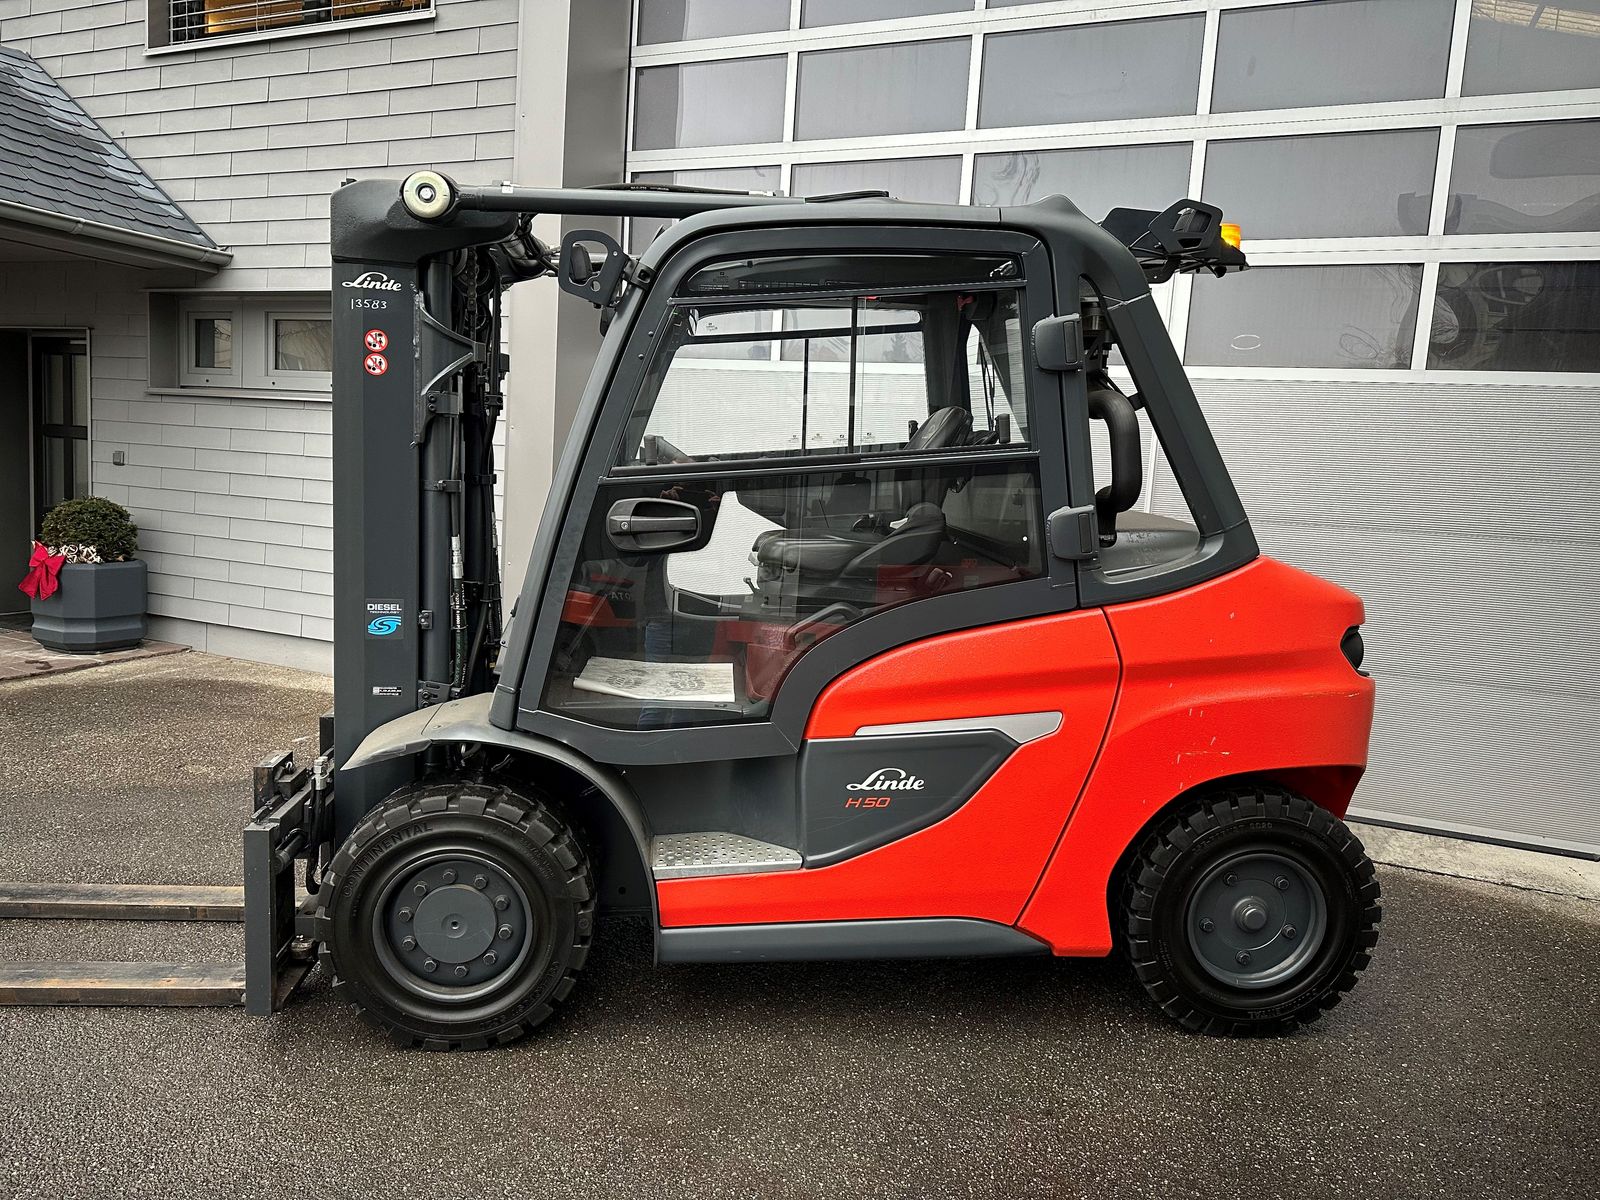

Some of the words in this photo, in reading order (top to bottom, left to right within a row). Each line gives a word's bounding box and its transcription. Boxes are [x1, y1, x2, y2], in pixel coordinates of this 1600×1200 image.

[341, 271, 402, 291] Linde
[351, 298, 387, 310] 13583
[367, 603, 402, 611] DIESEL
[846, 767, 925, 790] Linde
[343, 822, 433, 898] CONTINENTAL
